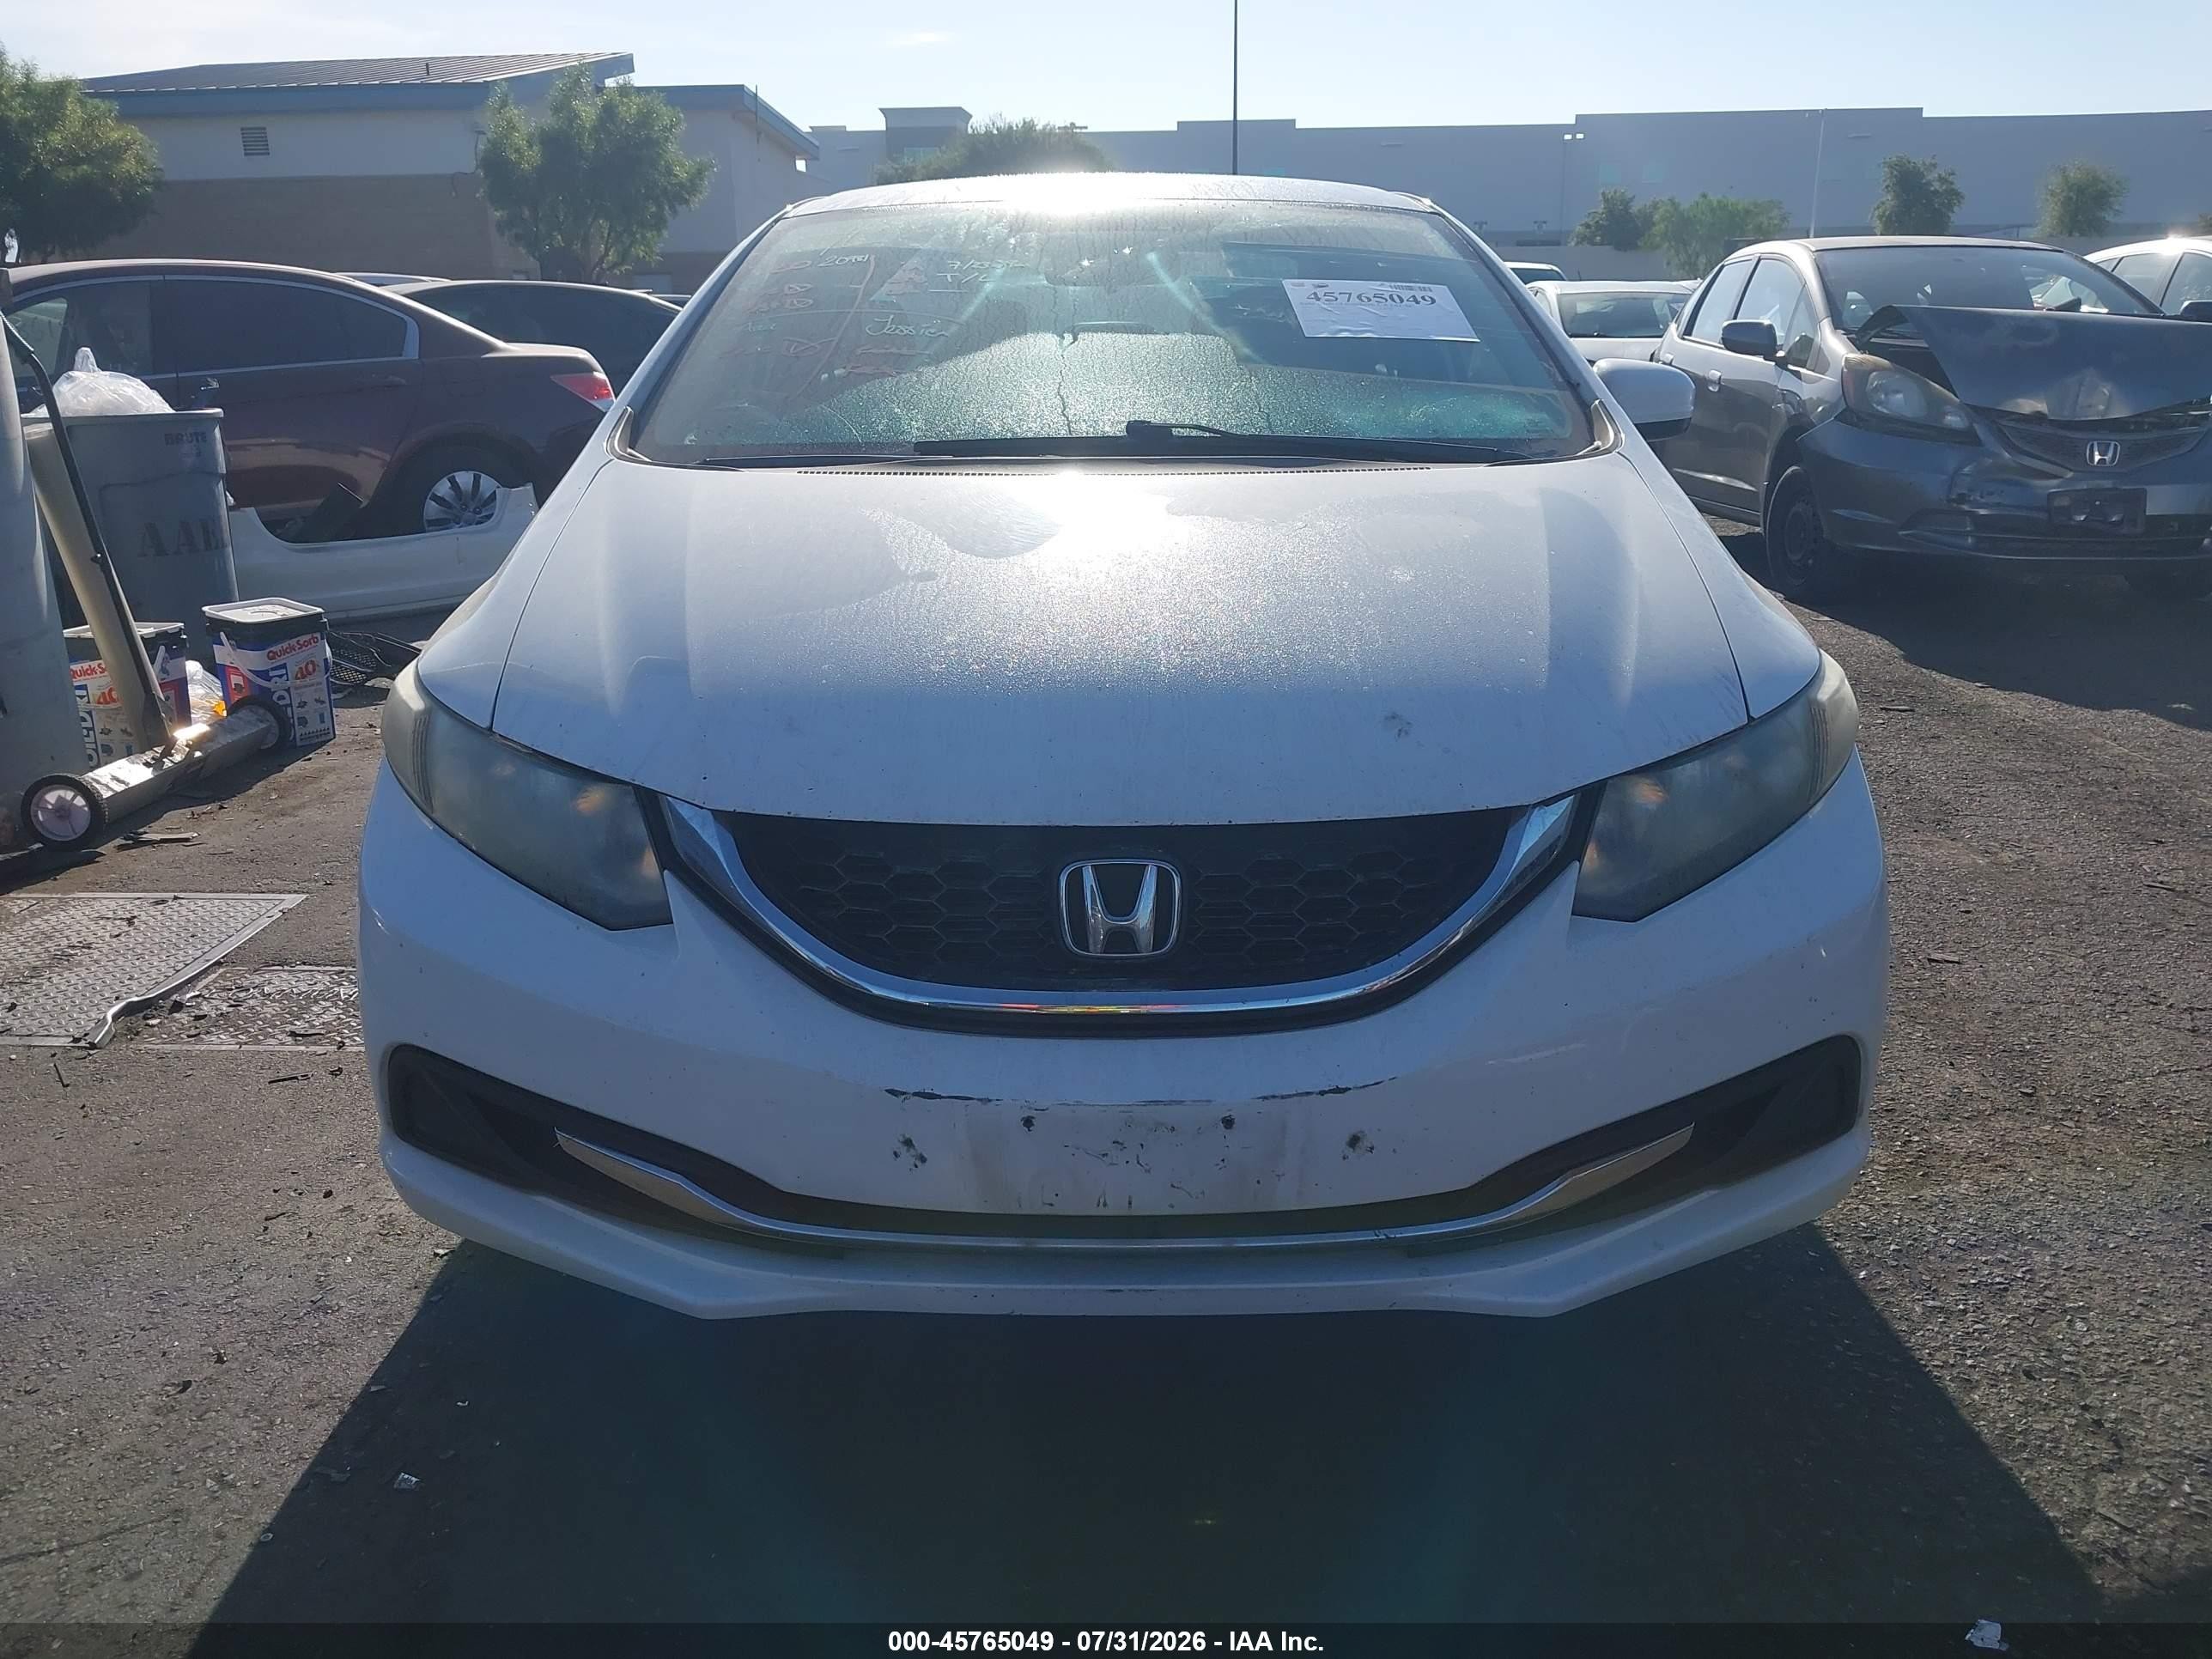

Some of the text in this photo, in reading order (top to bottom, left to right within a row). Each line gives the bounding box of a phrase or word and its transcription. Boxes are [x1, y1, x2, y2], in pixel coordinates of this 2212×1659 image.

[1305, 290, 1437, 306] 45765049
[164, 431, 207, 446] BRUTE
[266, 634, 319, 661] Quick-Sorb
[70, 662, 107, 680] Quick-S
